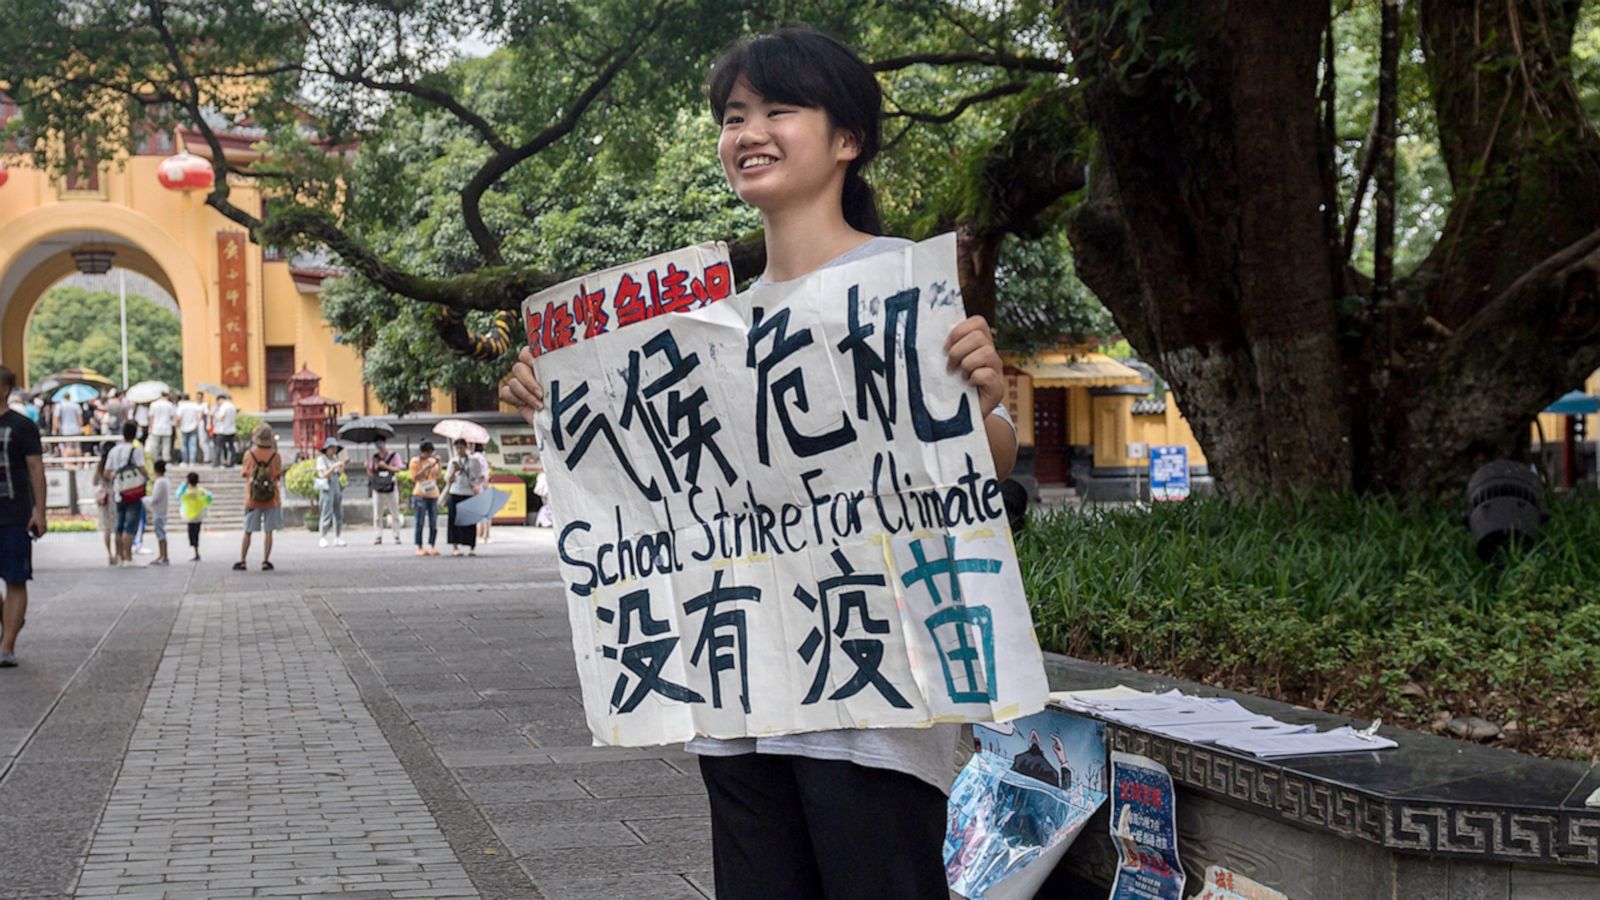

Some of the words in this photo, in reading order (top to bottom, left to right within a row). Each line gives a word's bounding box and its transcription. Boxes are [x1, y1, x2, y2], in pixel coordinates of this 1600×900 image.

[550, 284, 974, 502] 气候危机
[558, 496, 684, 597] School
[688, 480, 807, 561] Strike
[800, 468, 864, 545] For
[872, 450, 1002, 534] Climate
[596, 535, 1002, 715] 没有疫苗
